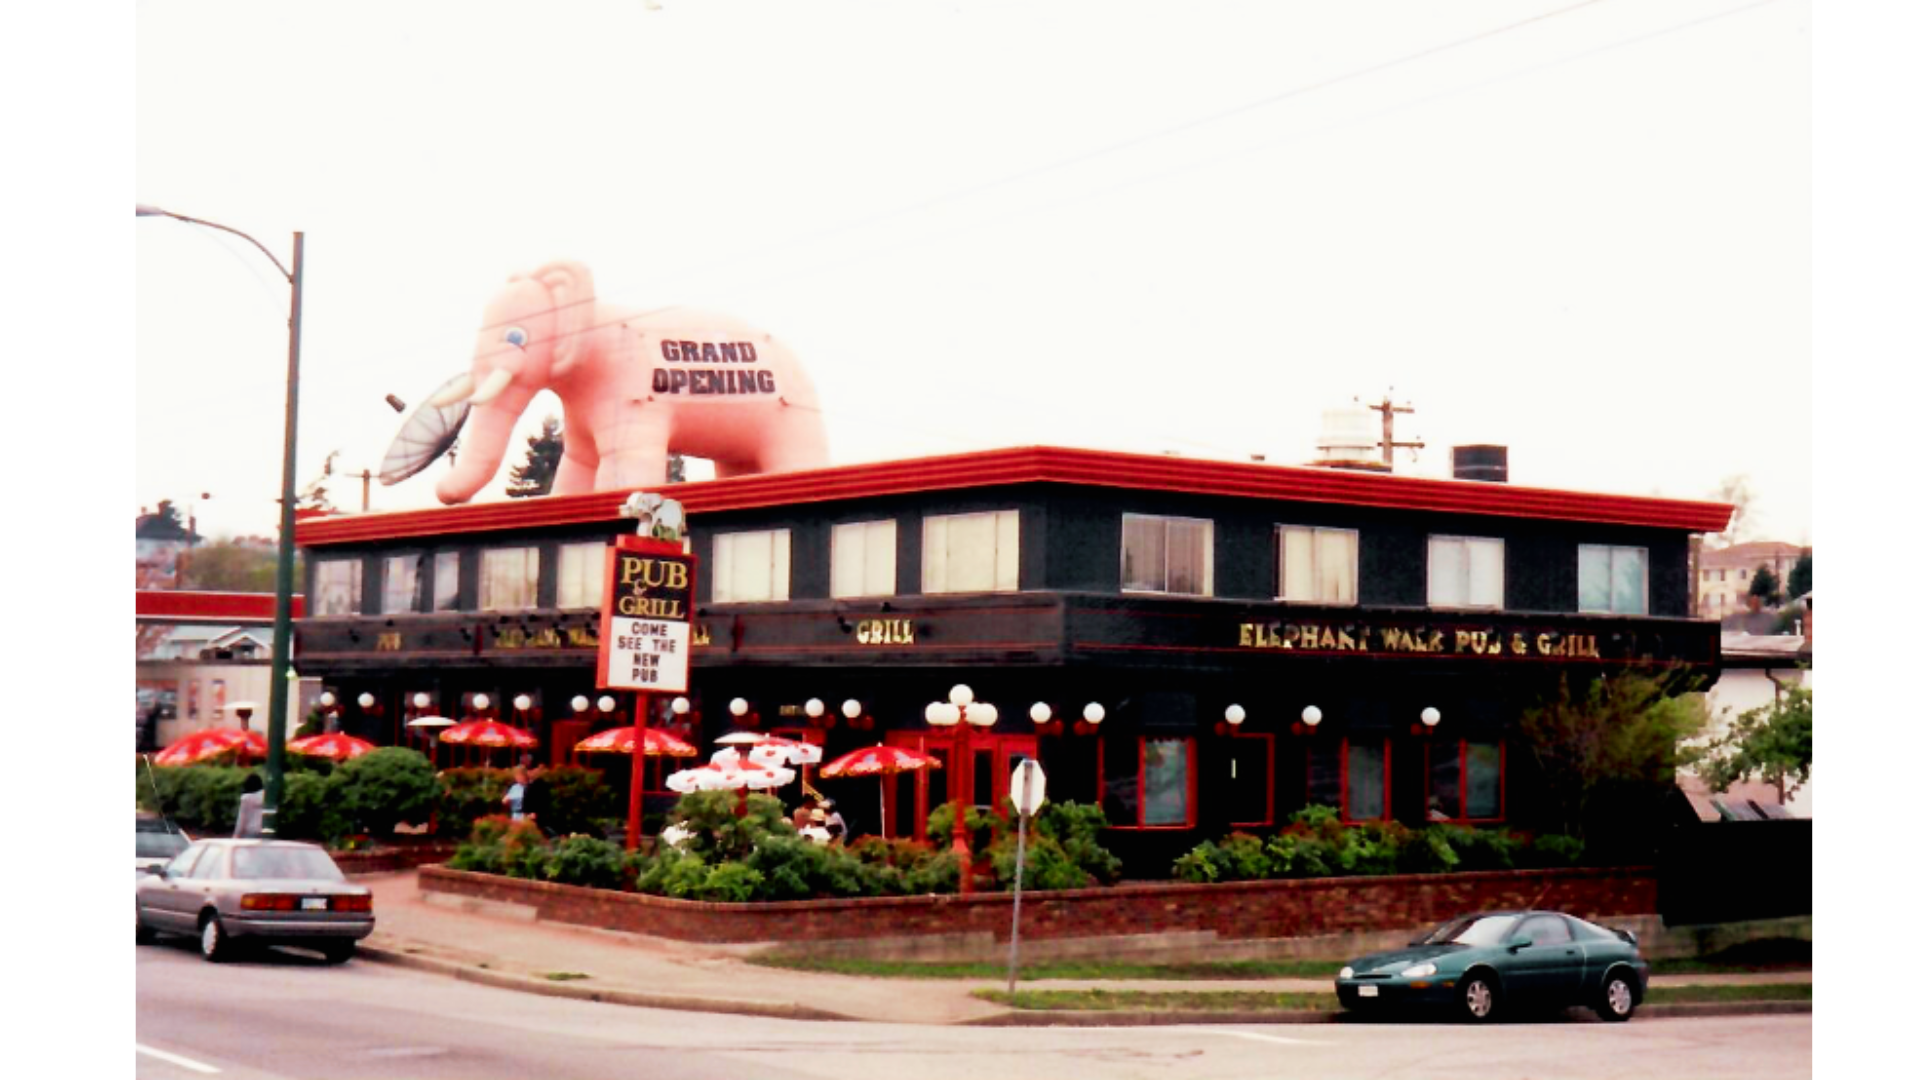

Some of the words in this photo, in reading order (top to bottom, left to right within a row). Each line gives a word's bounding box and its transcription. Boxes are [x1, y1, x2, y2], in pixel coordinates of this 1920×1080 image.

[660, 339, 758, 363] GRAND
[652, 368, 776, 395] OPENING
[621, 557, 689, 589] PUB
[632, 578, 647, 596] &
[618, 595, 685, 619] GRILL
[631, 621, 668, 637] COME
[857, 619, 914, 645] GRILL
[1238, 622, 1371, 652] ELEPHANT
[617, 635, 643, 650] SEE
[652, 638, 677, 653] THE
[633, 652, 661, 668] NEW
[632, 667, 659, 683] PUB
